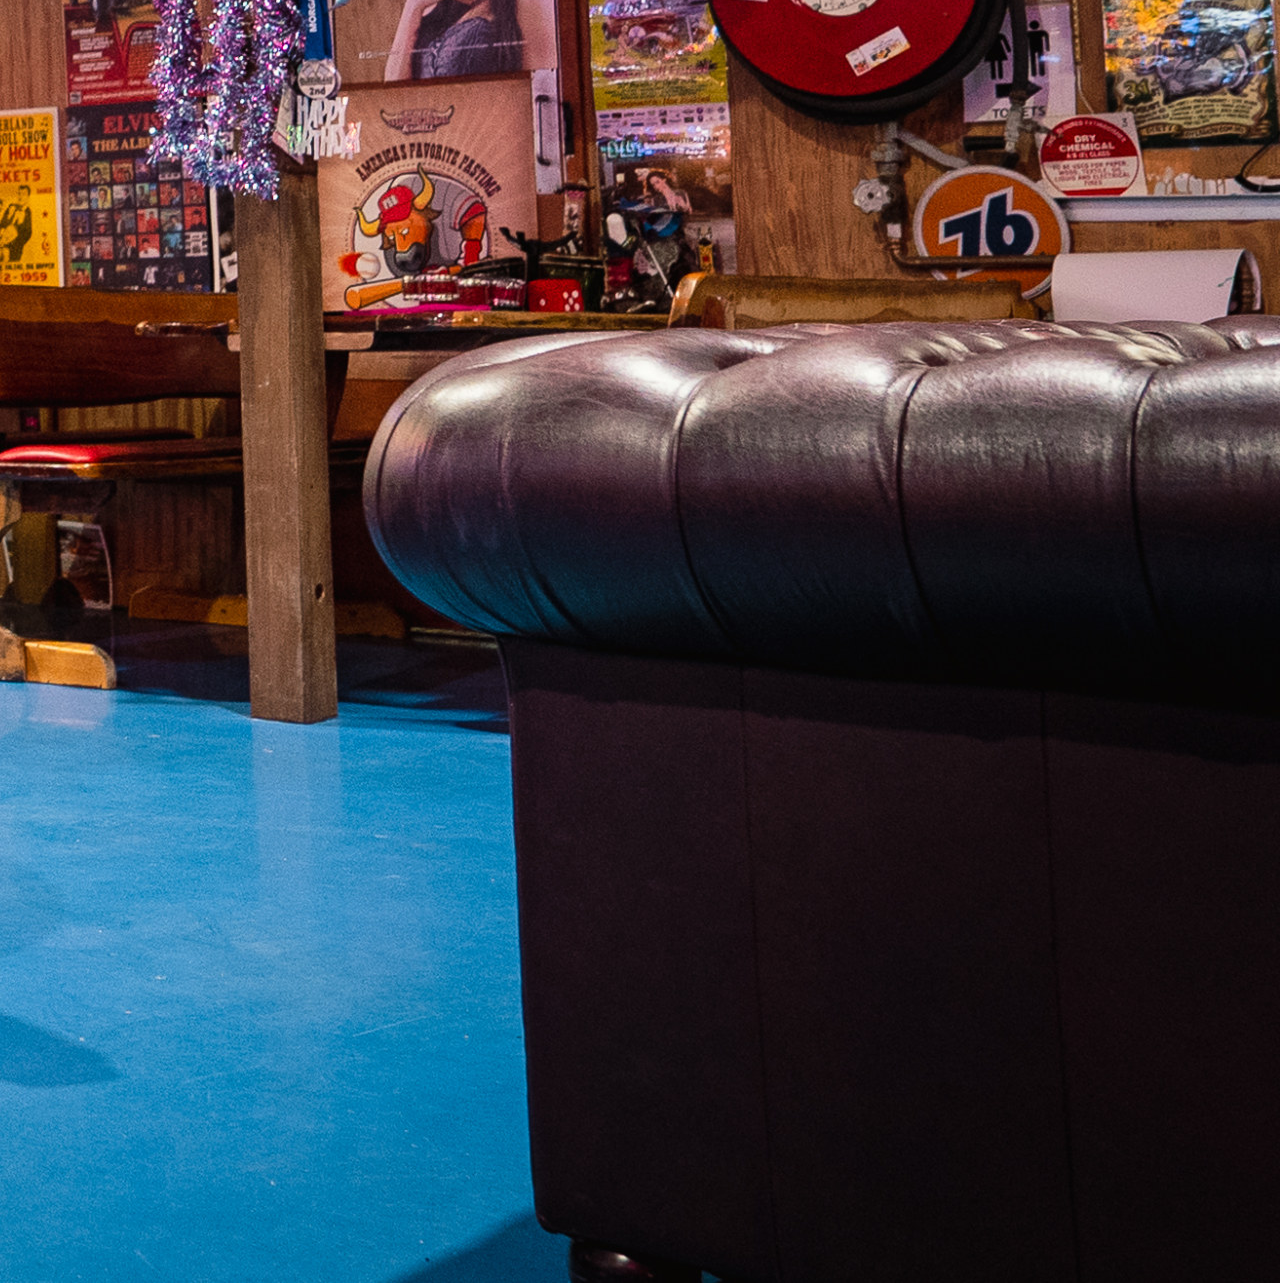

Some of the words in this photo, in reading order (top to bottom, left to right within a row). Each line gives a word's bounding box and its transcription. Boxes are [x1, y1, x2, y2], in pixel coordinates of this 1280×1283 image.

[309, 86, 326, 96] 2nd
[297, 96, 349, 129] HAPPY
[22, 128, 48, 143] SHOW
[1074, 134, 1096, 143] DRY
[9, 144, 50, 160] HOLLY
[92, 139, 117, 152] THE
[1059, 142, 1115, 153] CHEMICAL
[409, 142, 458, 165] FAVORITE
[457, 152, 502, 198] PASTIME
[939, 186, 1041, 280] 76
[21, 271, 48, 282] 1959
